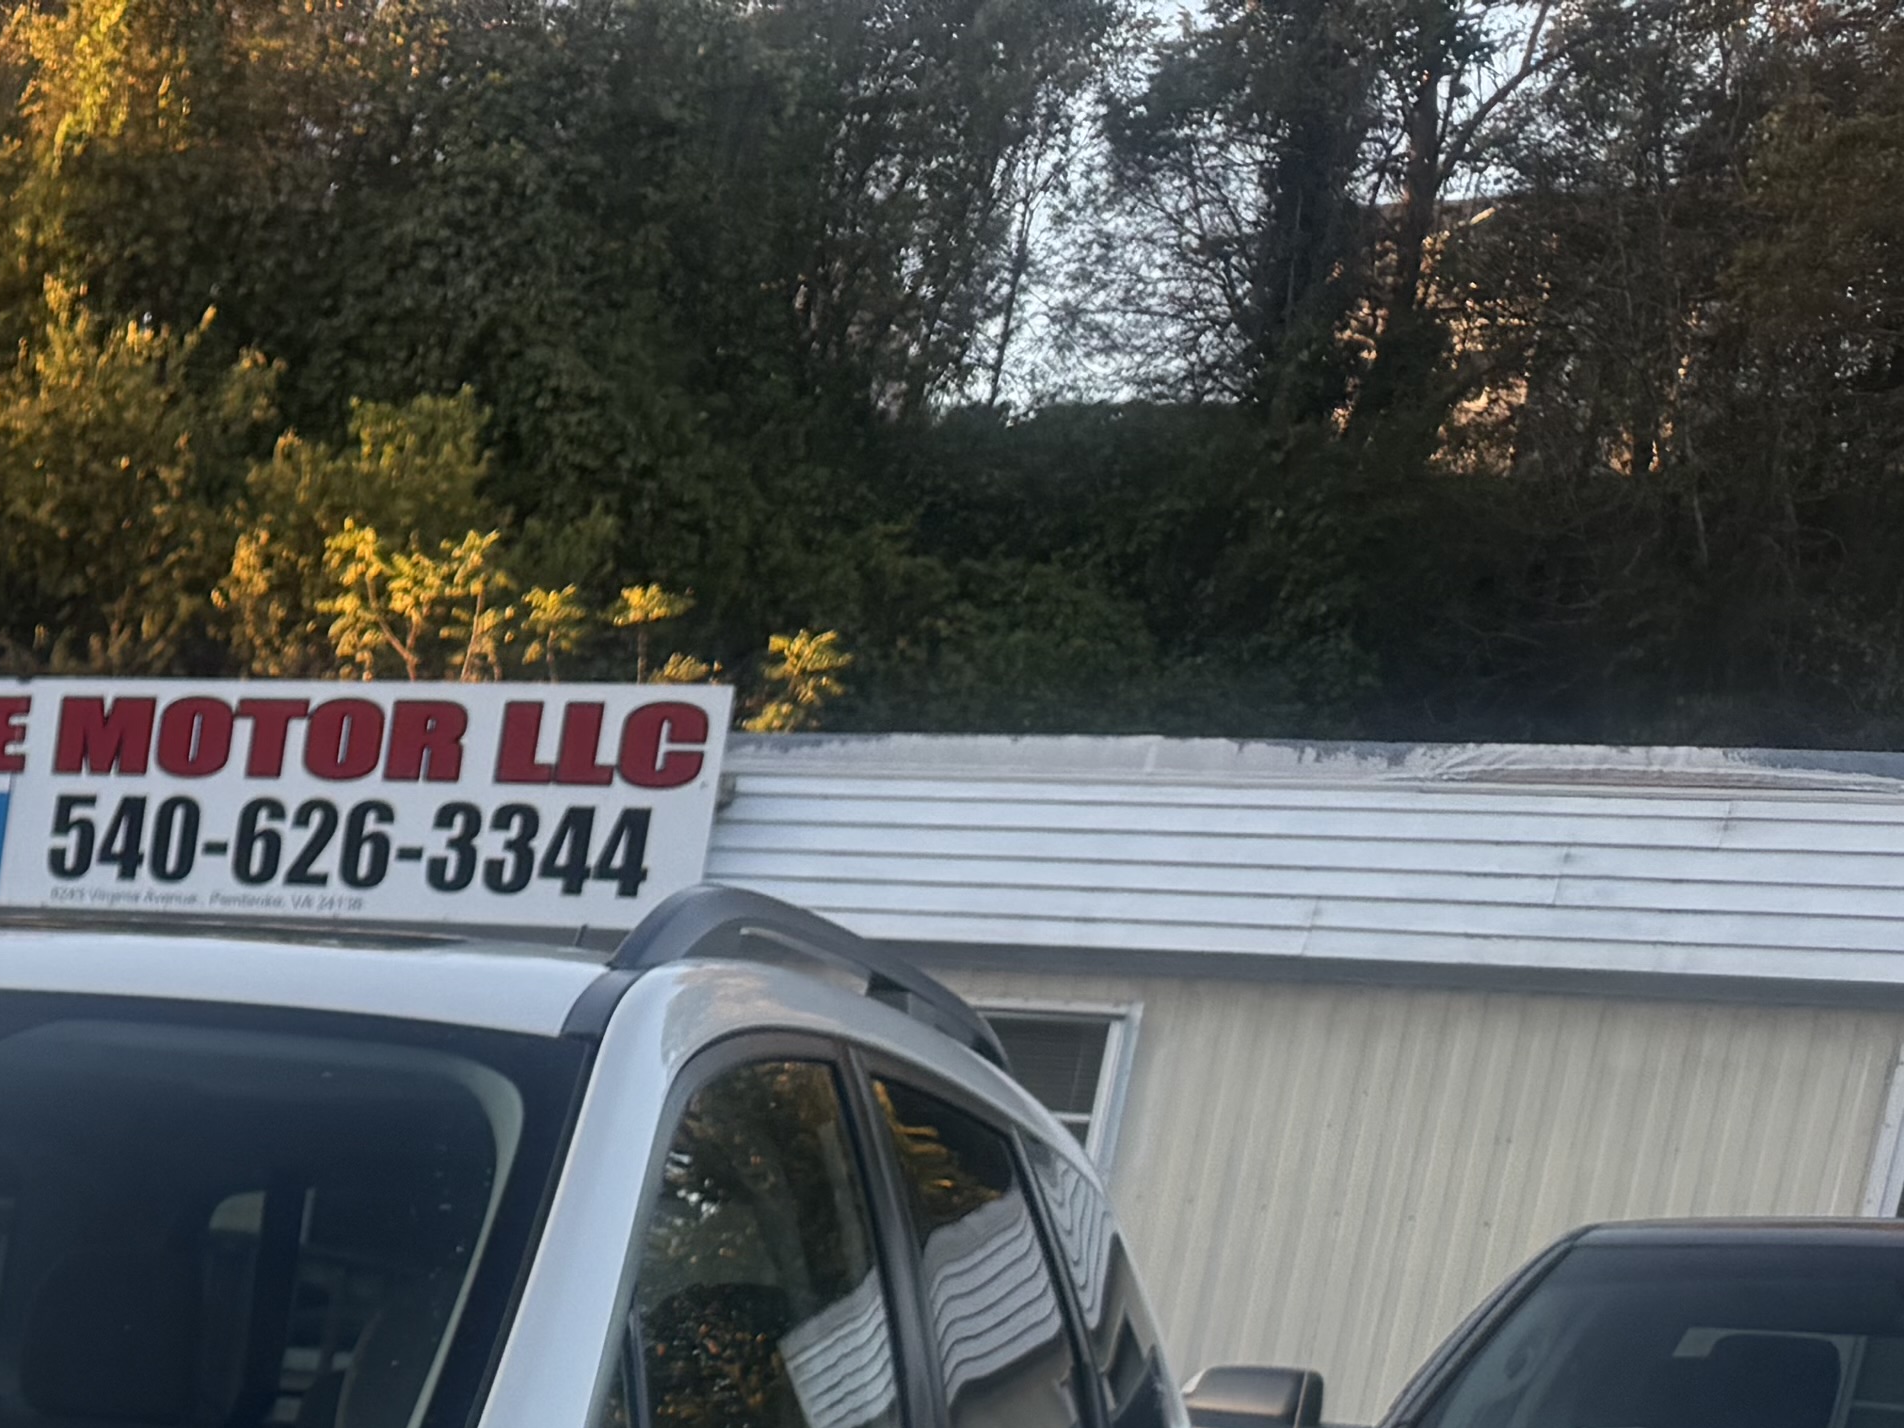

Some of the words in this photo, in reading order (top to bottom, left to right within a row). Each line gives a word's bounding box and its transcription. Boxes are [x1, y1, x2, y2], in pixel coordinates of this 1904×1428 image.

[51, 695, 468, 783] MOTOR
[495, 700, 710, 790] LLC
[47, 794, 653, 899] 540-626-3344
